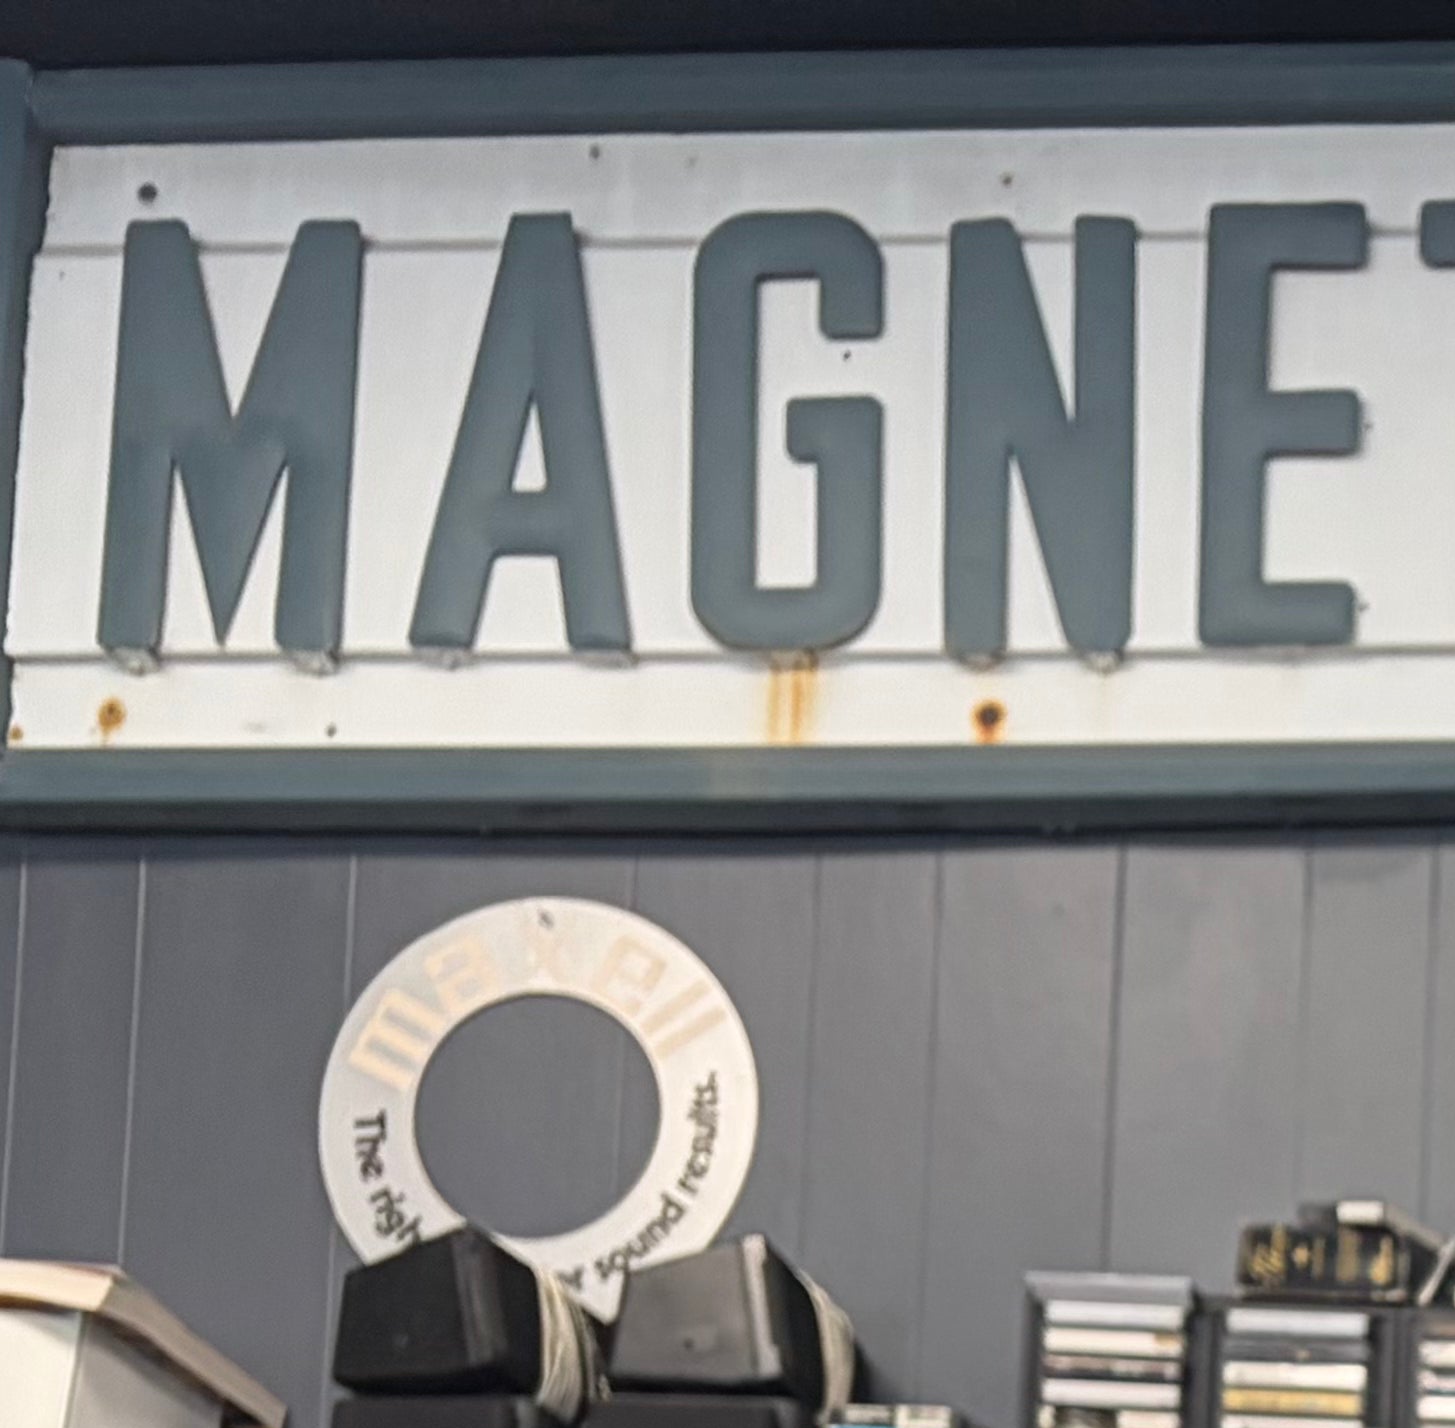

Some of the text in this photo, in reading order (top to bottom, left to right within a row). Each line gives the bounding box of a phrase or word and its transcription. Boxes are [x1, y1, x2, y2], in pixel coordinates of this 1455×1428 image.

[354, 1108, 423, 1244] The righ
[594, 1192, 686, 1280] sound
